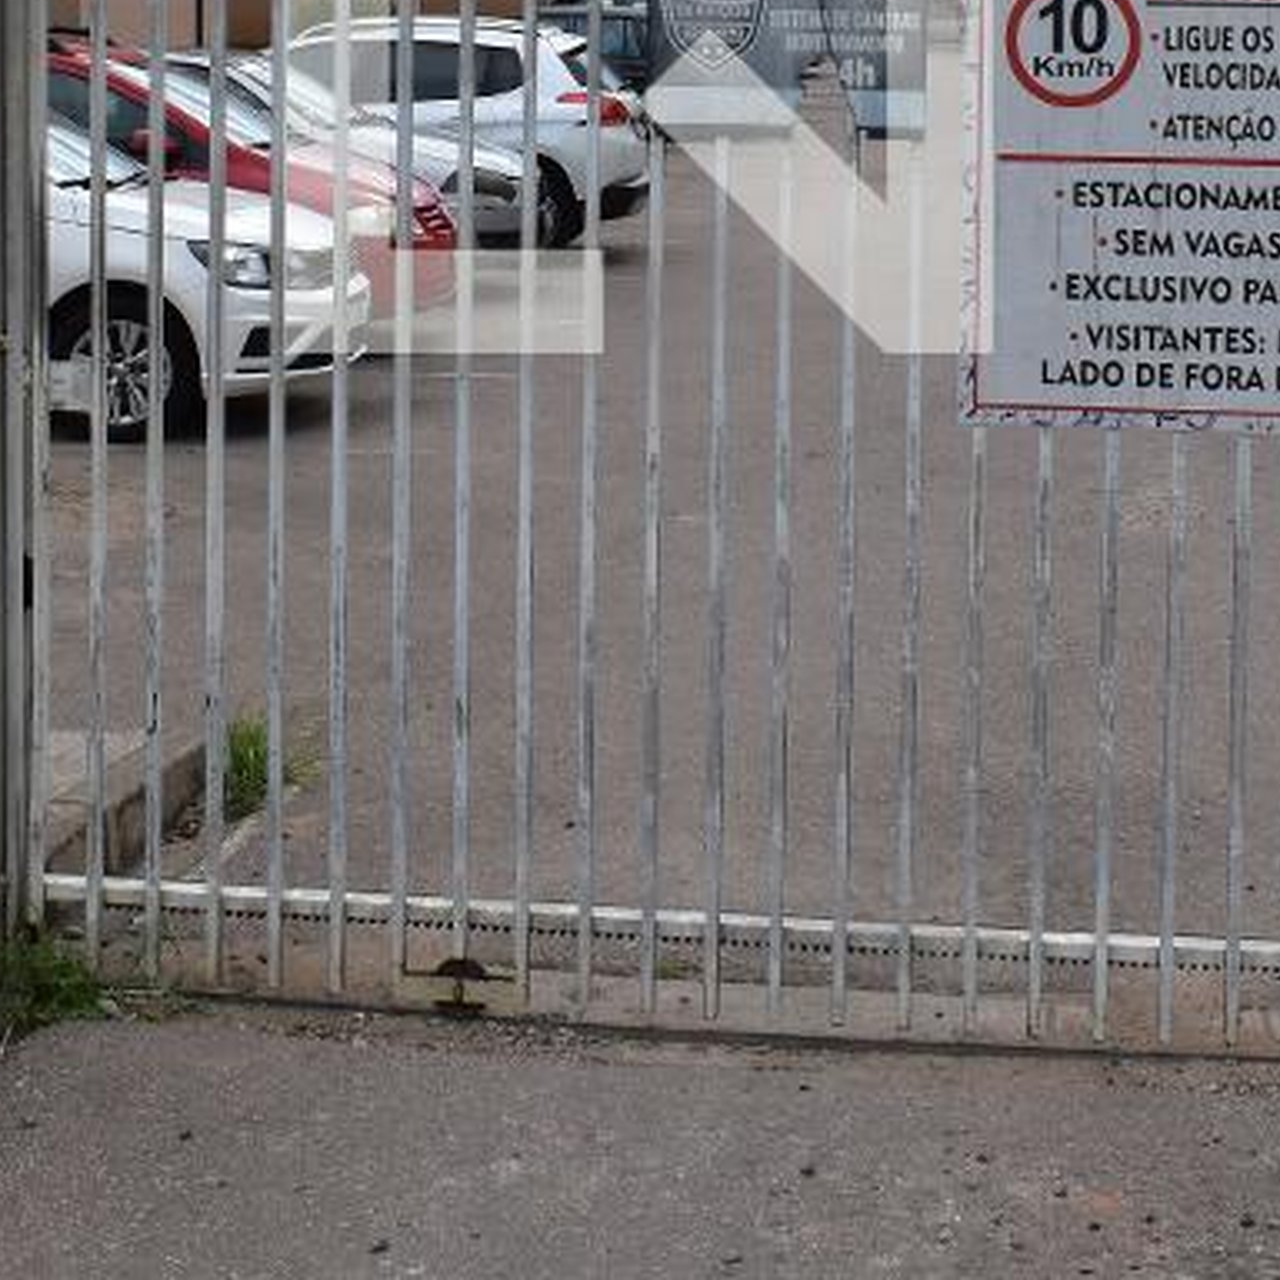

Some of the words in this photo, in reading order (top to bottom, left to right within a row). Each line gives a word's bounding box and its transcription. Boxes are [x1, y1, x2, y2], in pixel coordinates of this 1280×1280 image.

[1163, 25, 1234, 53] LIGUE
[1241, 25, 1275, 54] OS
[835, 59, 876, 88] 4h
[1032, 56, 1115, 78] Km/h
[1162, 108, 1277, 148] ATENÇÃO
[1113, 228, 1175, 257] SEM
[1065, 273, 1233, 305] EXCLUSIVO
[1085, 323, 1266, 355] VISITANTES:
[1040, 358, 1125, 388] LADO
[1135, 362, 1174, 390] DE
[1184, 362, 1266, 392] FORA
